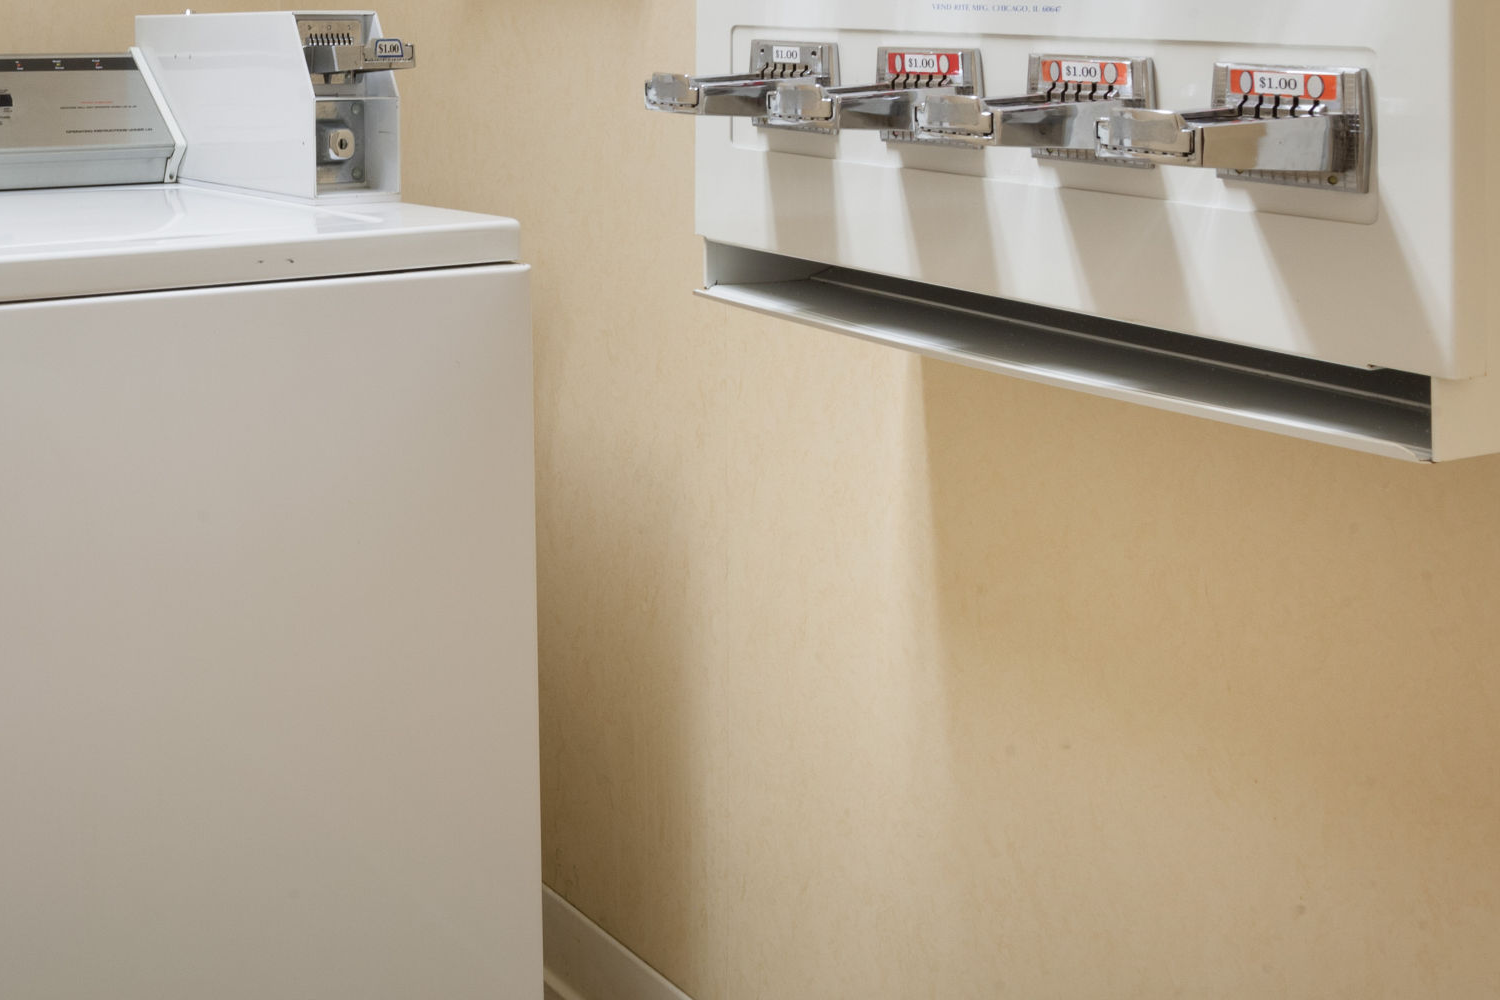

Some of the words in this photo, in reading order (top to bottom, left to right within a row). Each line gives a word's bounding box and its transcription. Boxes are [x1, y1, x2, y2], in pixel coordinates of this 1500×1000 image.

[378, 43, 400, 54] $1.00
[775, 49, 798, 60] $1.00
[908, 57, 934, 70] $1.00
[1065, 66, 1098, 78] $1.00
[1258, 76, 1298, 90] $1.00
